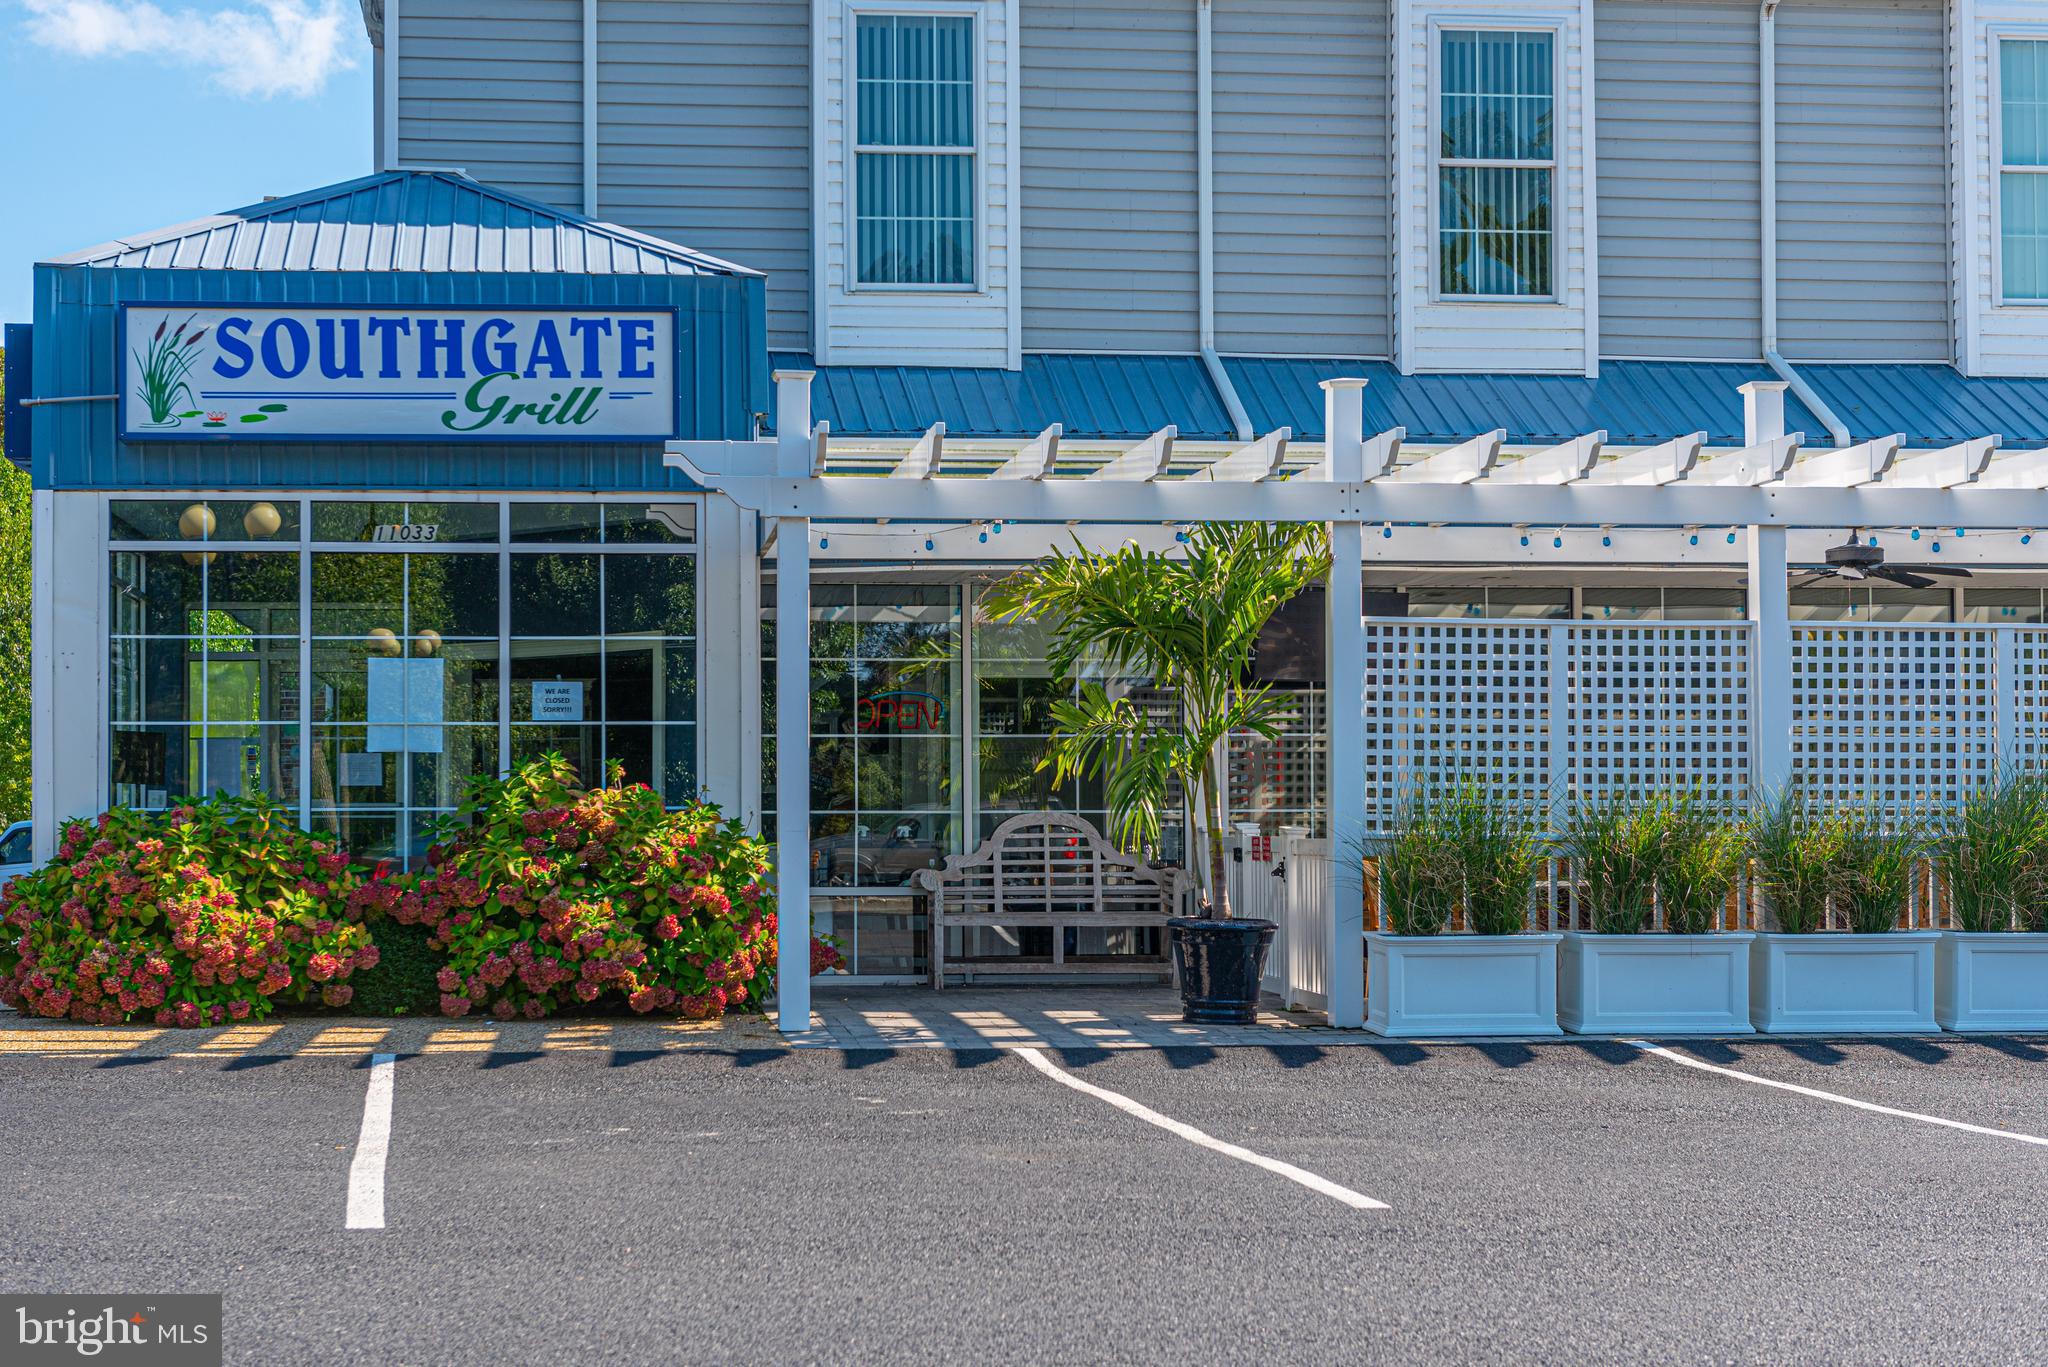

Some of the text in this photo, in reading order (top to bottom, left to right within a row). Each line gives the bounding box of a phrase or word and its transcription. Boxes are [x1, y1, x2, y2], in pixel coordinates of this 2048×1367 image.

[212, 316, 655, 379] SOUTHGATE
[441, 372, 604, 431] Grill
[377, 525, 435, 541] 11033
[856, 698, 939, 730] OPEN
